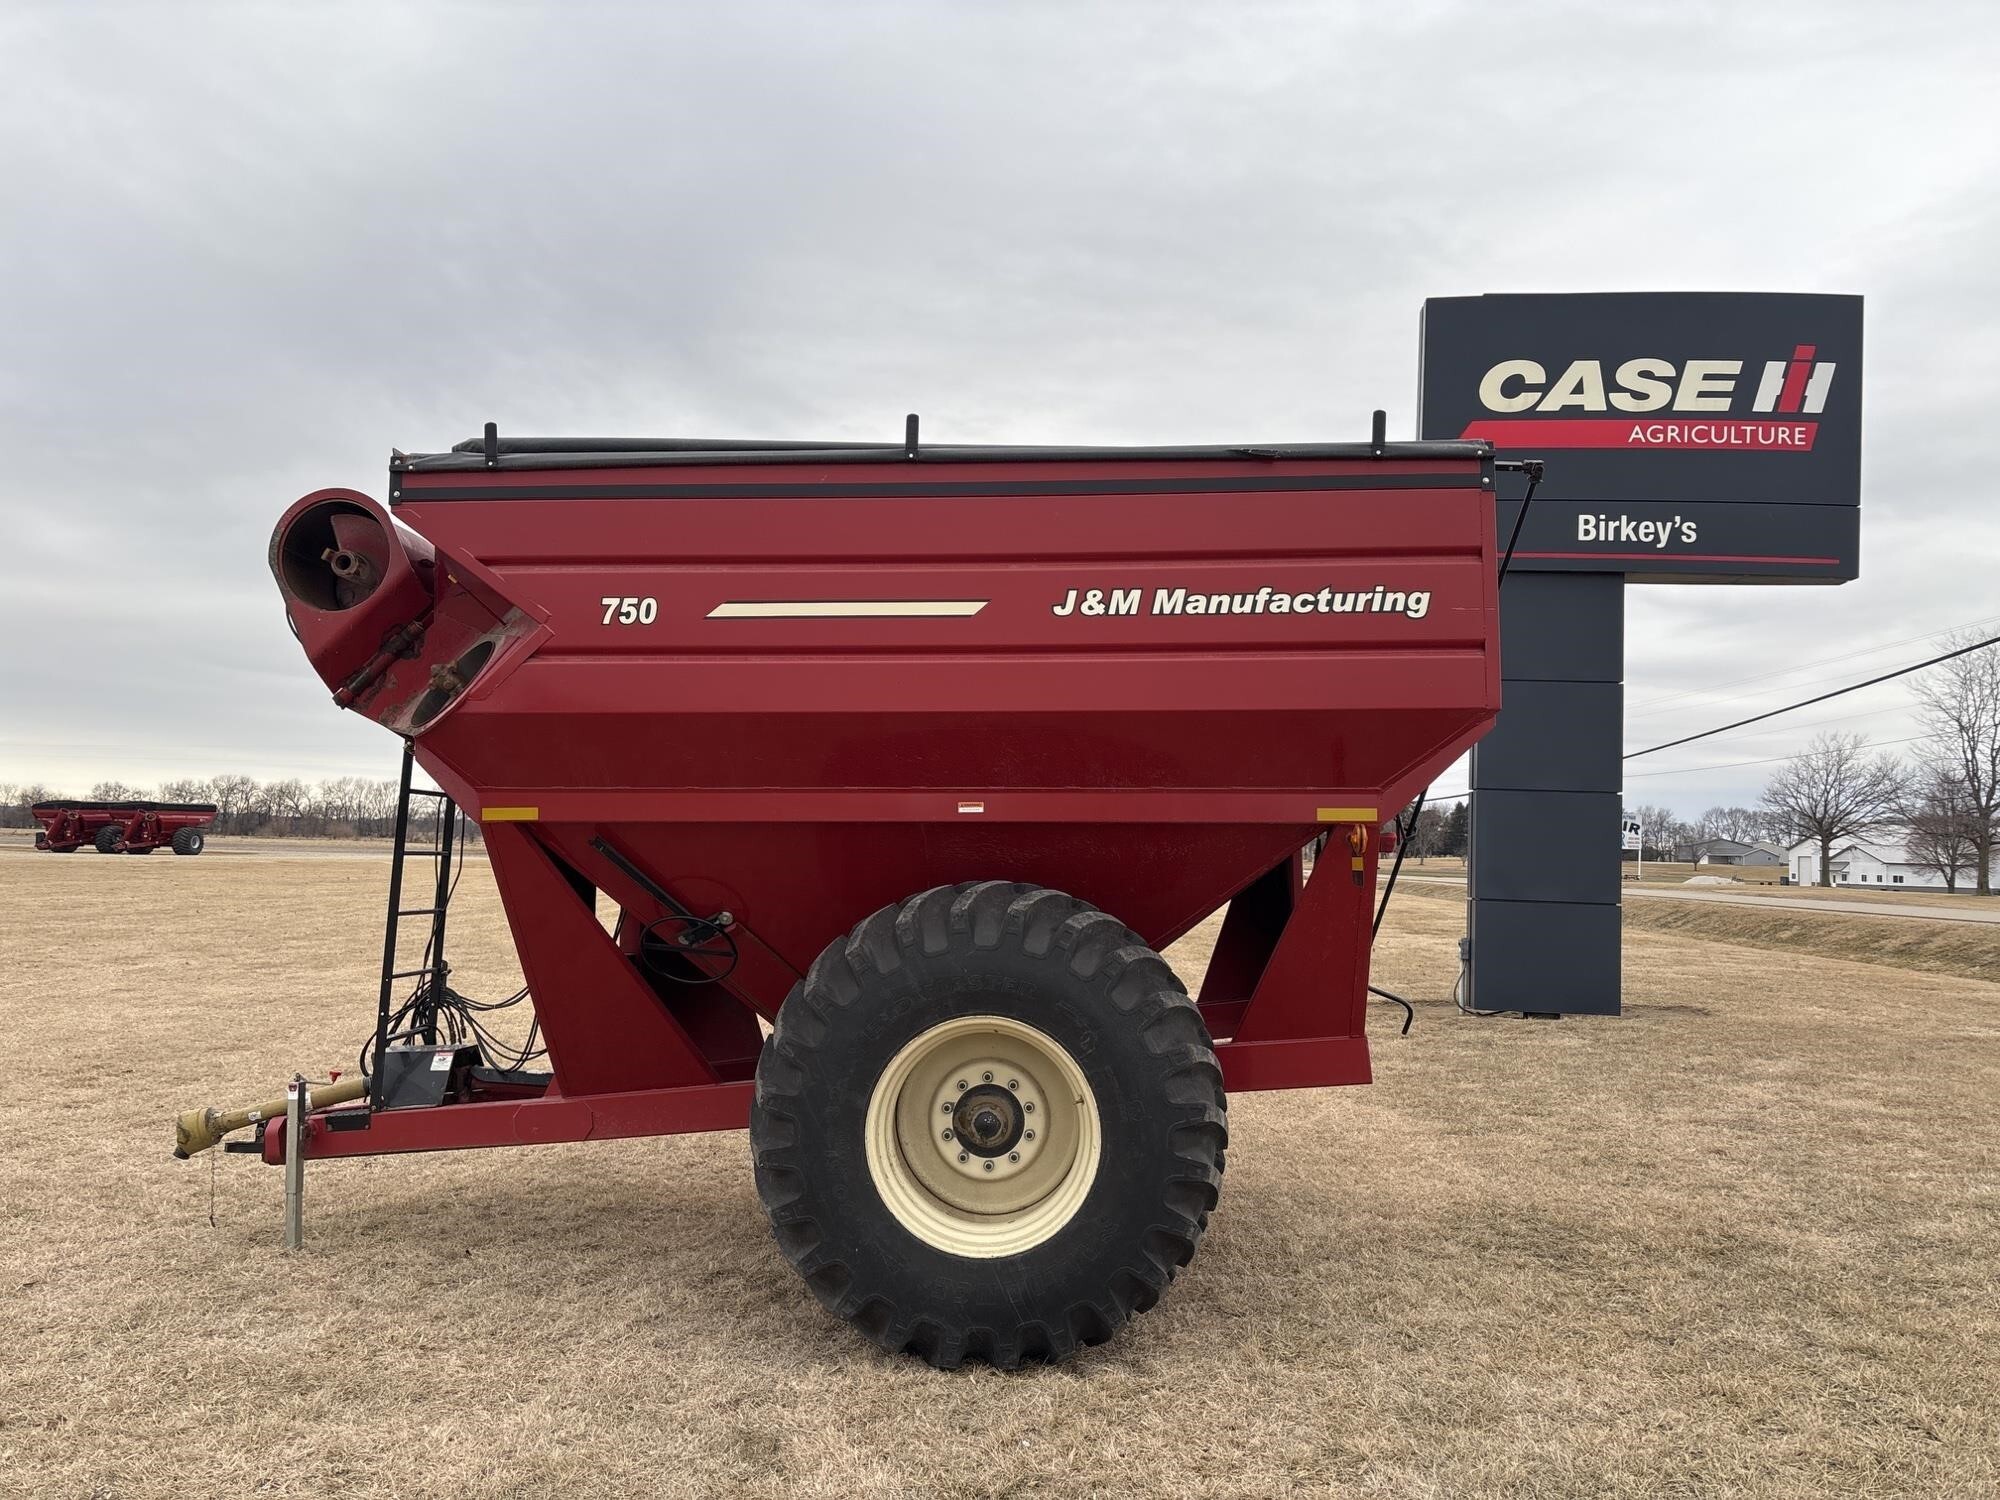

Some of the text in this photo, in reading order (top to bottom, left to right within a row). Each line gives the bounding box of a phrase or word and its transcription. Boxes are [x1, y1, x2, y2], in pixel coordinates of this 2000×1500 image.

[1478, 357, 1744, 413] CASE
[1628, 424, 1807, 446] AGRICULTURE
[1577, 513, 1698, 549] Birkey’s
[600, 596, 659, 626] 750
[1052, 585, 1432, 619] J&M Manufacturing
